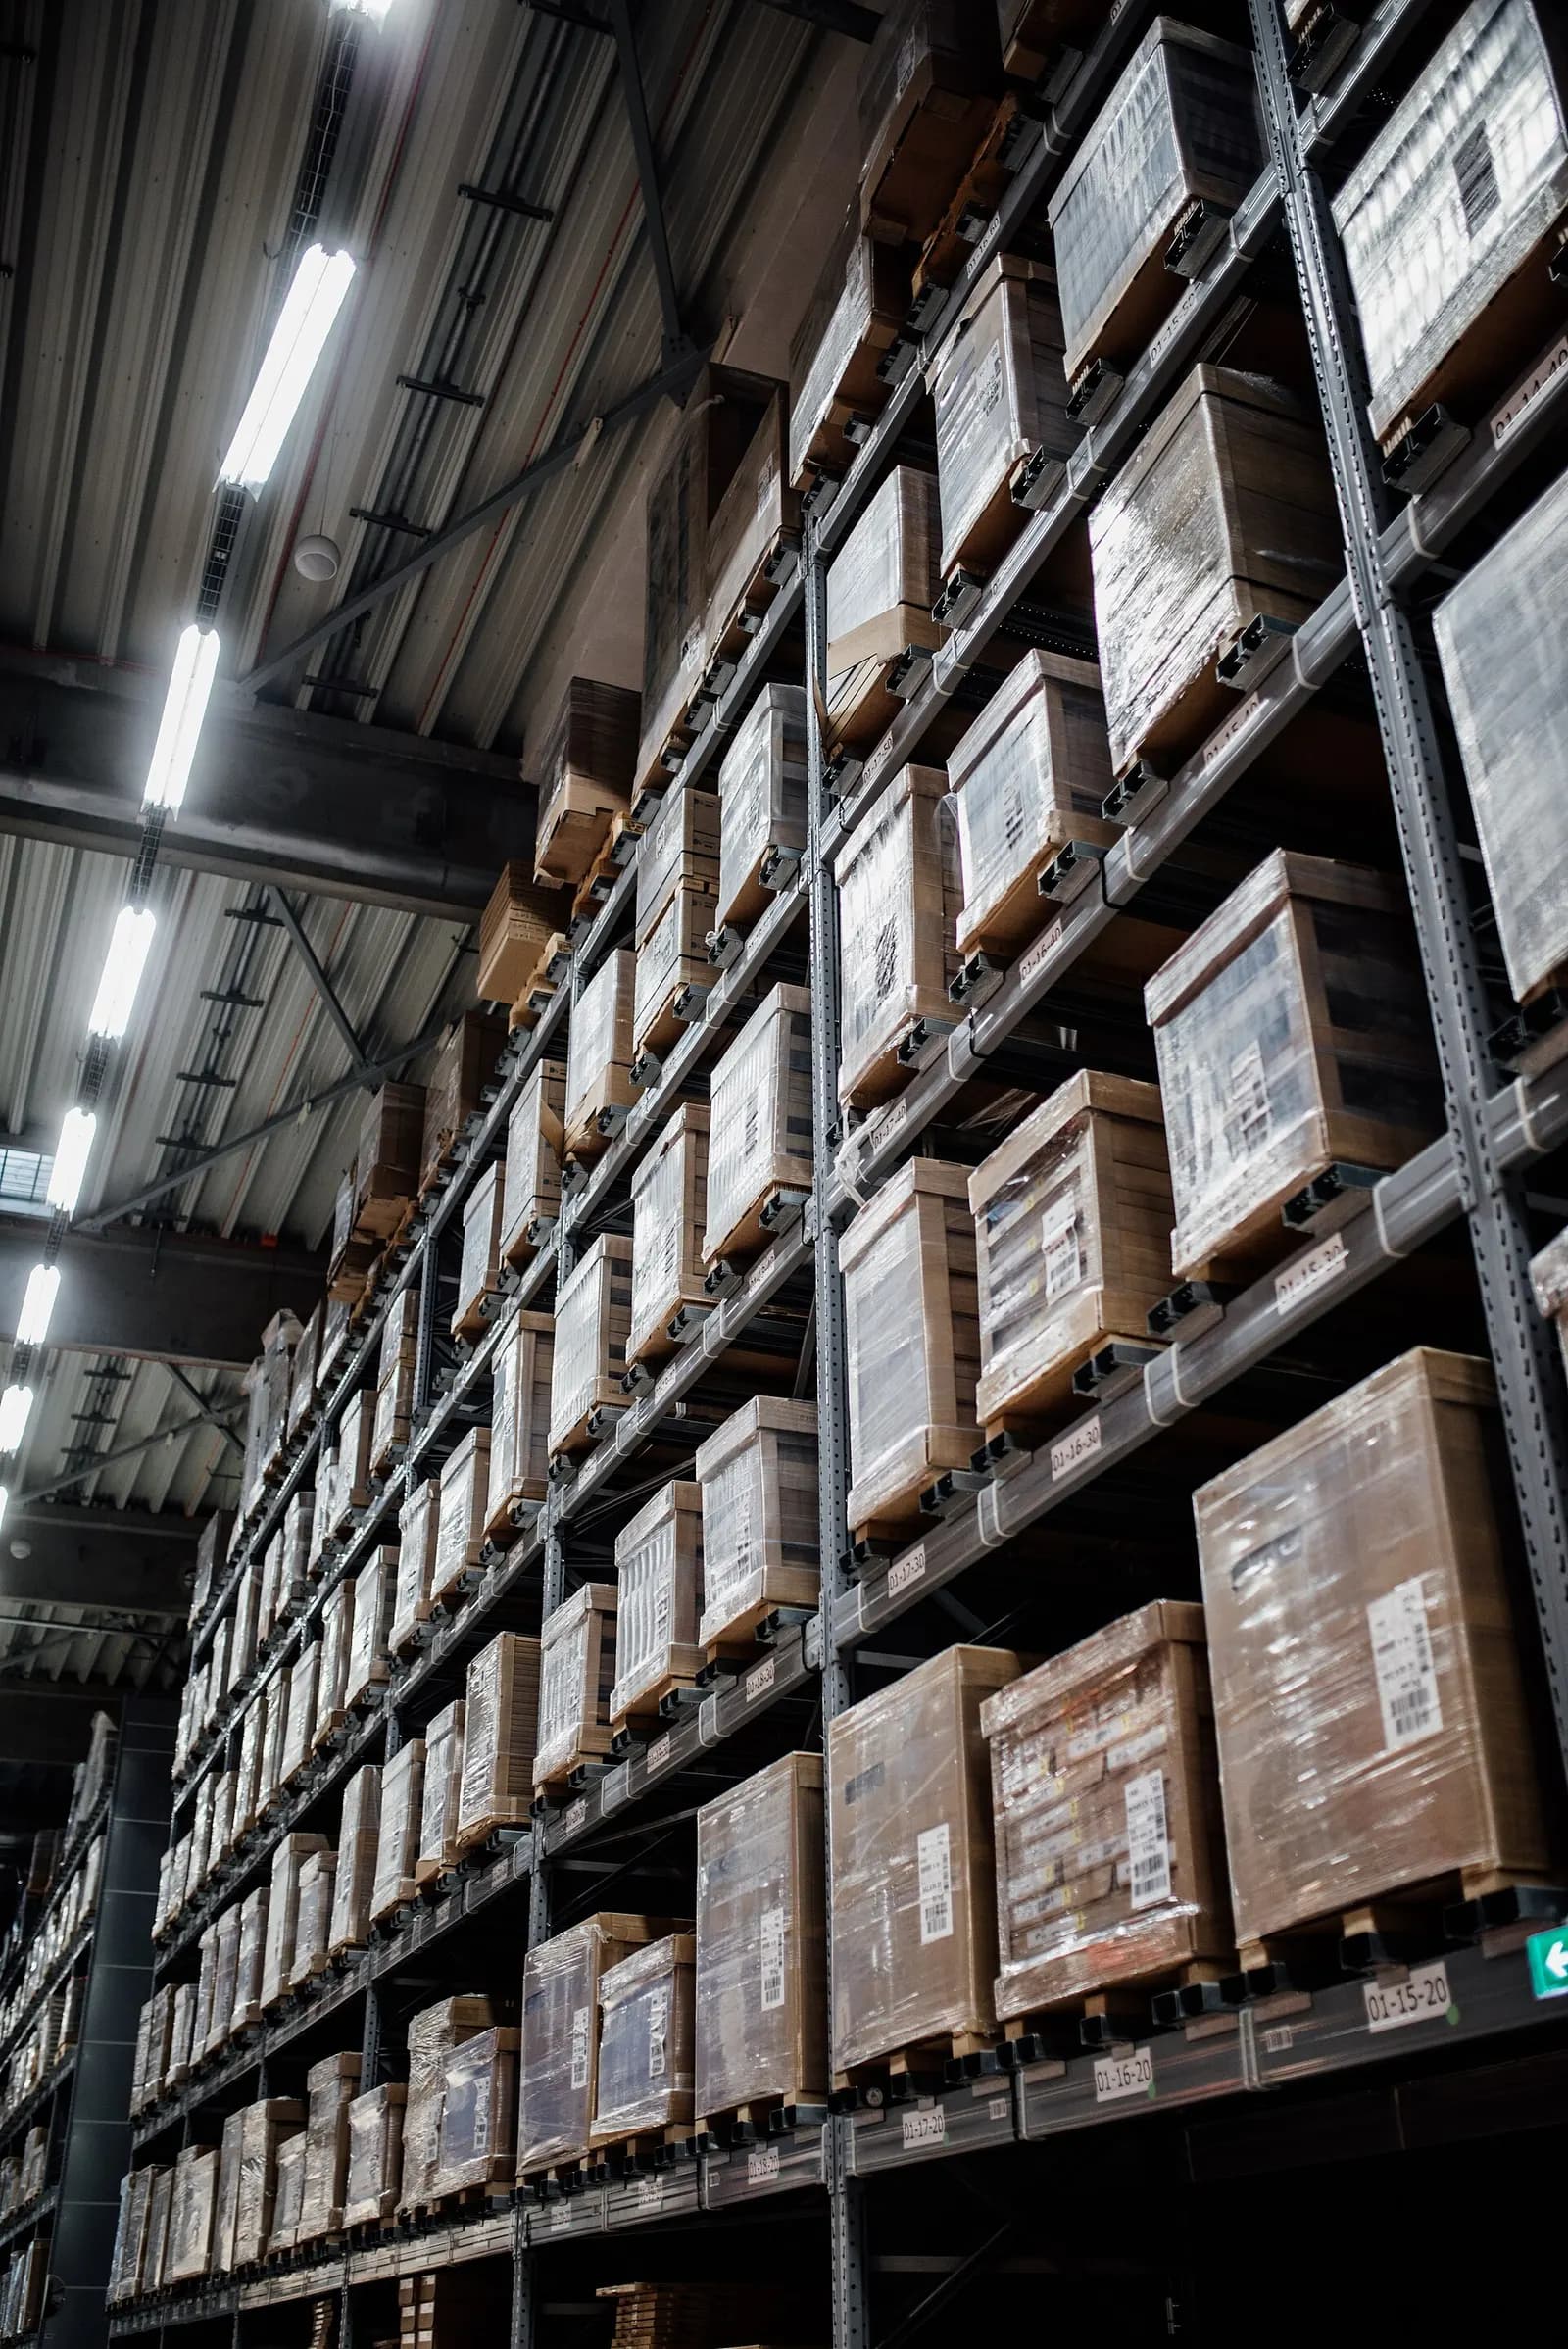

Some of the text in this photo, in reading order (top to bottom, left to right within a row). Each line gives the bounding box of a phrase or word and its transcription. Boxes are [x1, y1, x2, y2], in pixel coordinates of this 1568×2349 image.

[1053, 1426, 1099, 1472] 01-16-30
[889, 1552, 925, 1590] 01-17-30
[1369, 1977, 1447, 2021] 01-15-20
[1097, 2059, 1152, 2092] 01-16-20
[904, 2115, 944, 2140] 01-17-20
